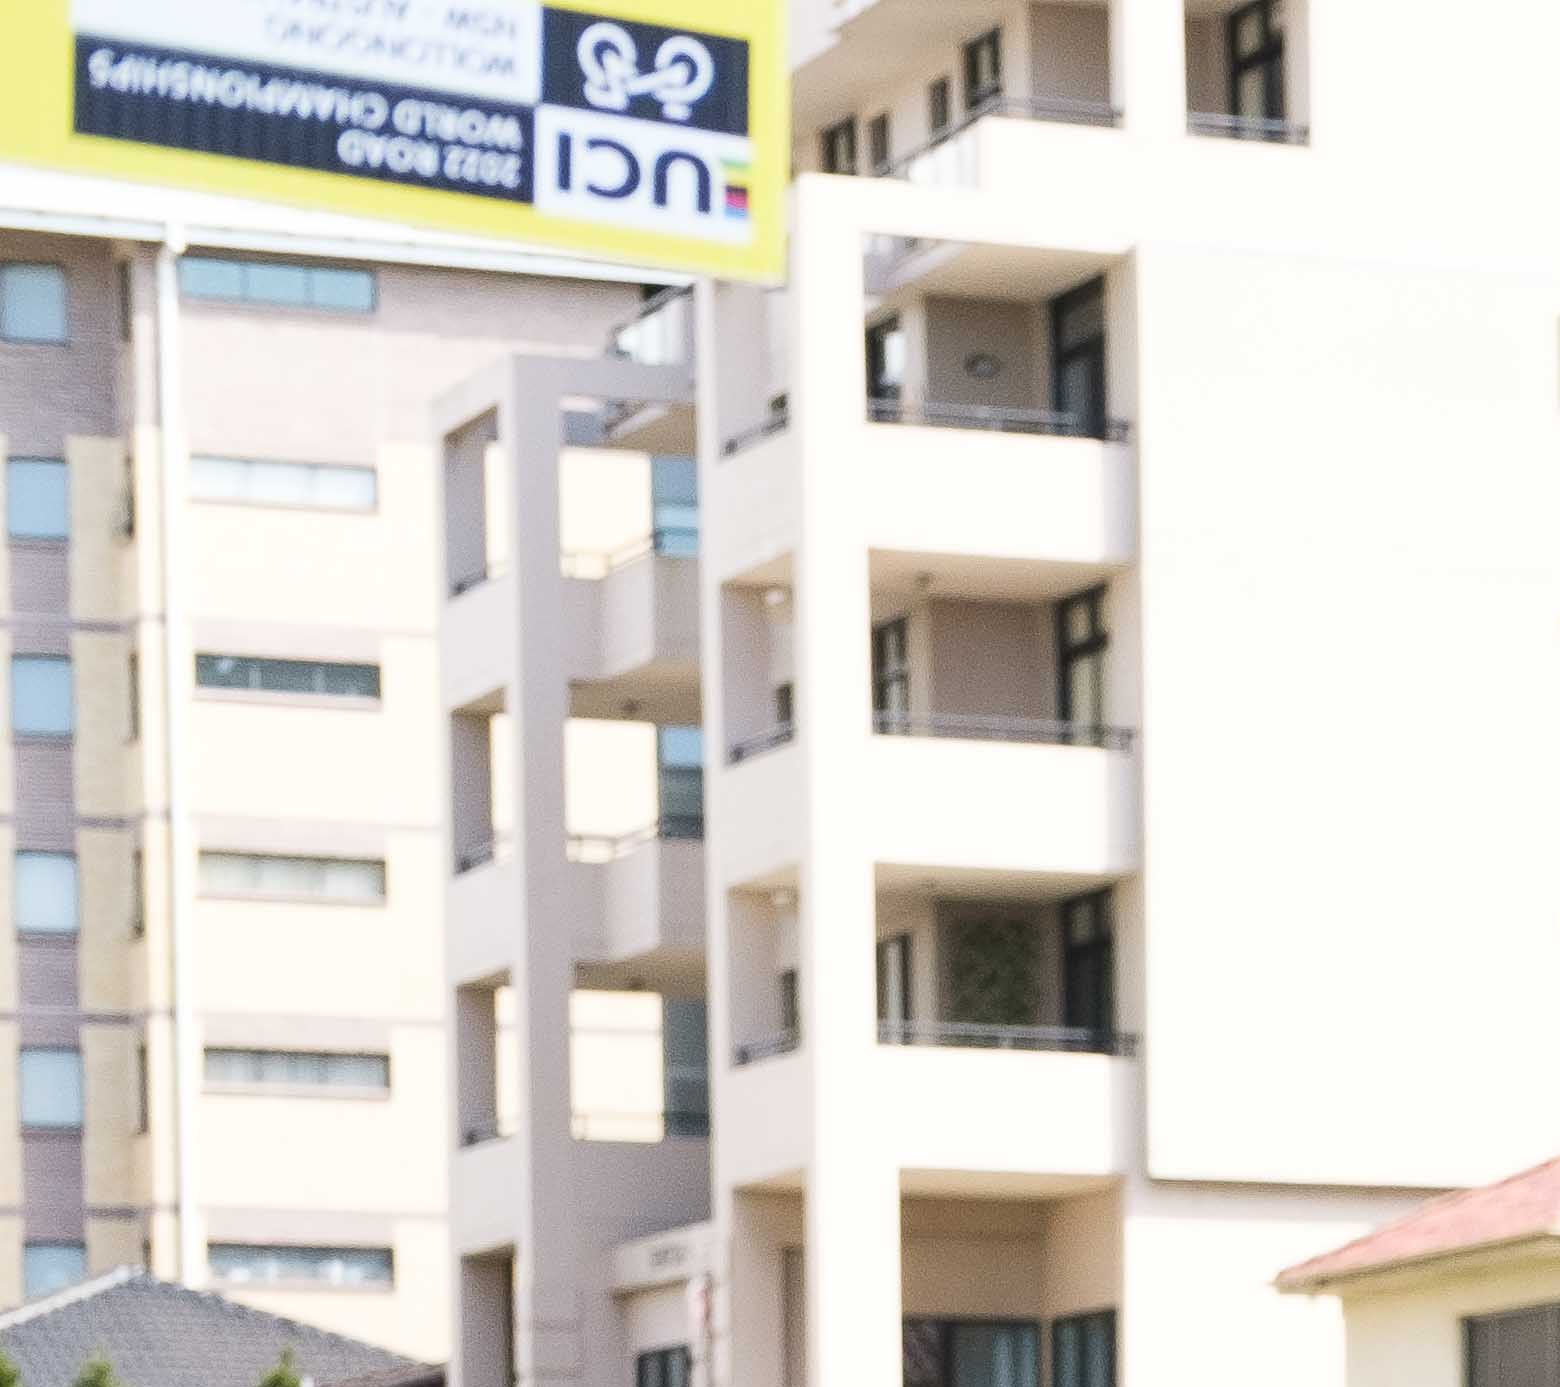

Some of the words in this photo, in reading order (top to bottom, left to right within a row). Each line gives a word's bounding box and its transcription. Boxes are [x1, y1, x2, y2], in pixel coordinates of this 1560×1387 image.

[262, 16, 519, 77] WOLLONGONG
[87, 47, 390, 130] CHAMPIONSHIPS
[393, 97, 524, 150] WORLD
[336, 128, 439, 180] ROAD
[442, 144, 522, 188] 2022
[556, 131, 714, 216] UCI
